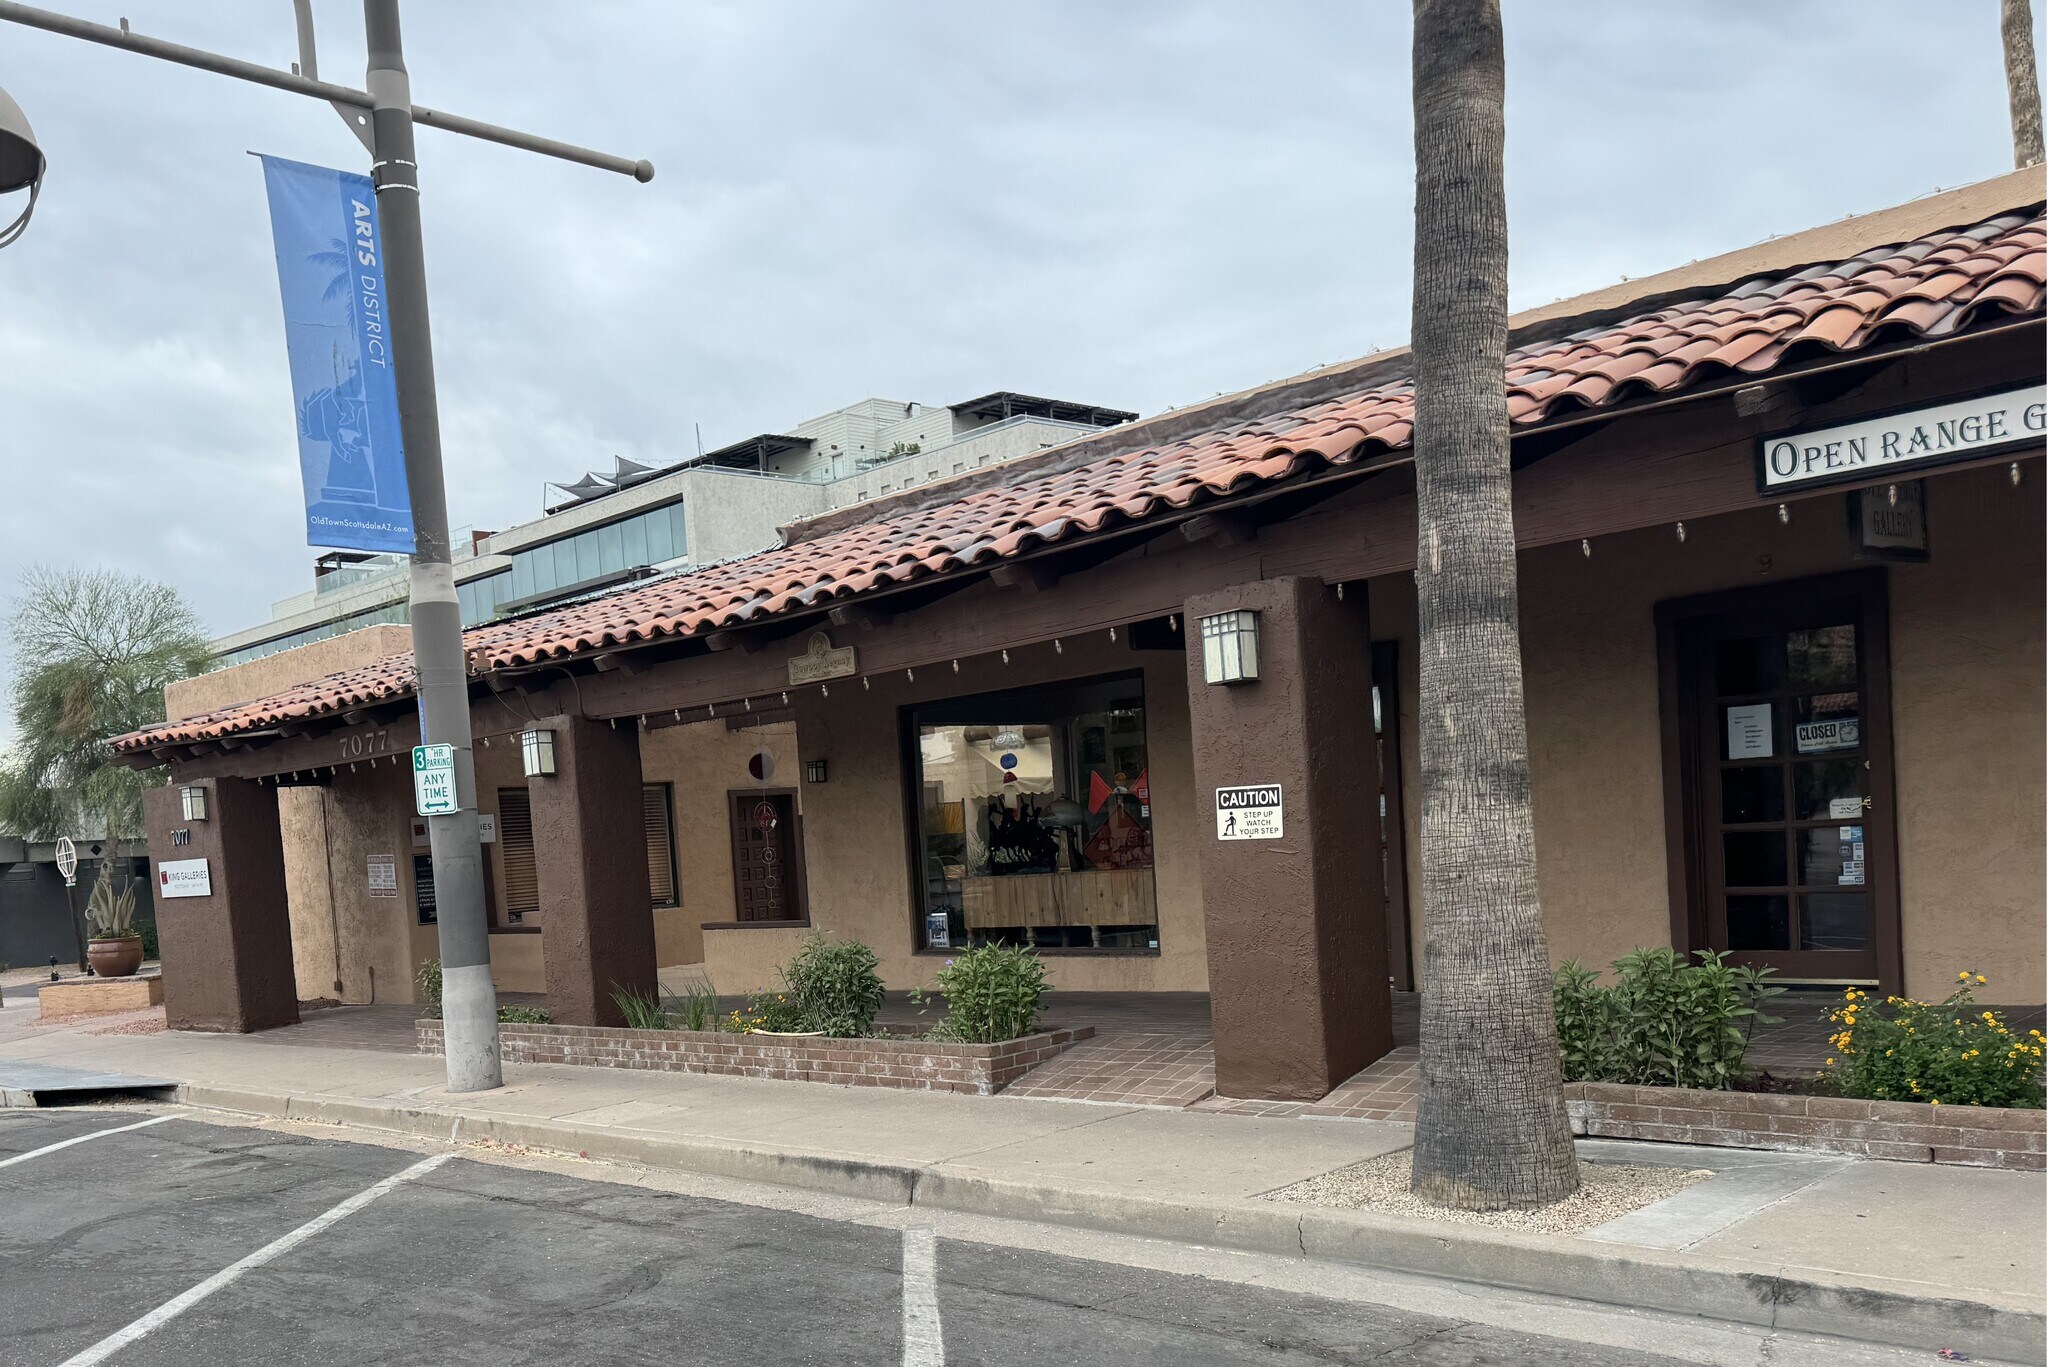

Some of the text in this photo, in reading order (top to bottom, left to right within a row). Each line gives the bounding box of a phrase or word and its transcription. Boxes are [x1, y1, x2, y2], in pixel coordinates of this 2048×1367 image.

[351, 199, 385, 368] ARTS DISTRICT
[1770, 437, 1867, 477] OPEN
[1881, 410, 2009, 459] RANGE
[1799, 724, 1836, 741] CLOSED
[339, 730, 387, 758] 7077
[416, 749, 443, 769] 3 HR
[427, 757, 450, 767] PARKING
[424, 773, 446, 785] ANY
[424, 787, 448, 799] TIME
[1220, 790, 1278, 807] CAUTION
[168, 869, 207, 881] KING GALLERIES
